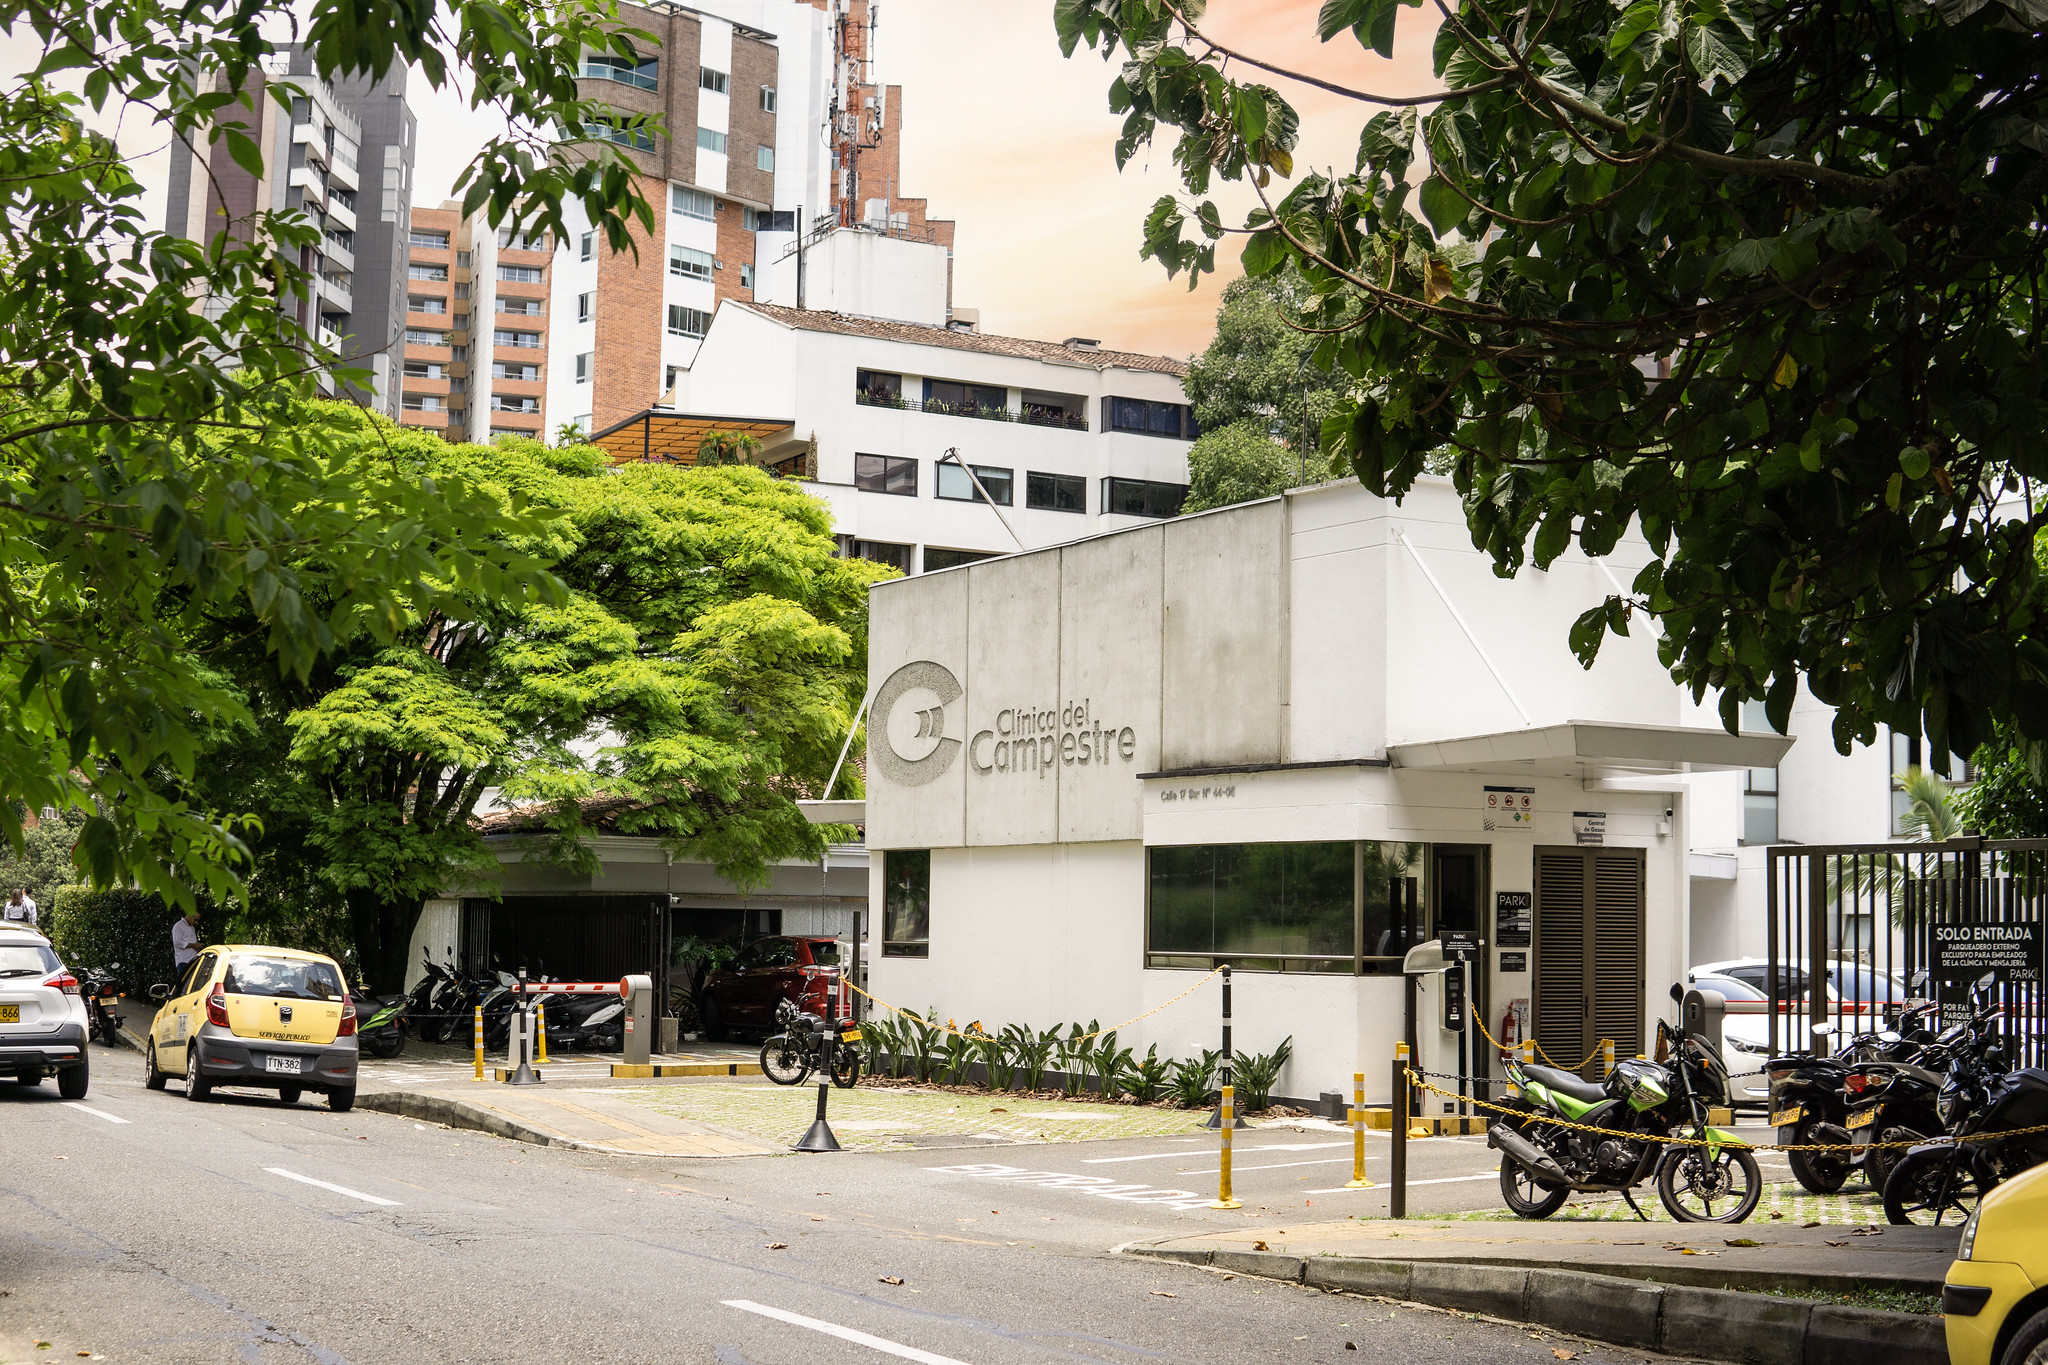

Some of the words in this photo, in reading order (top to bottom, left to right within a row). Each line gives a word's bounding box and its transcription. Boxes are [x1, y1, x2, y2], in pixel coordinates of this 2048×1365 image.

[996, 706, 1056, 737] Clínica
[1062, 698, 1090, 728] del
[969, 719, 1136, 780] Campestre
[1161, 790, 1177, 801] Calle
[1189, 788, 1200, 799] Sur
[1499, 895, 1526, 906] PARK
[1936, 927, 1971, 940] SOLO
[1973, 927, 2032, 940] ENTRADA
[1948, 943, 1992, 951] PARQUEADERO
[1993, 943, 2020, 951] EXTERNO
[1941, 951, 1974, 959] EXCLUSIVO
[1974, 951, 1991, 959] PARA
[1991, 951, 2028, 959] EMPLEADOS
[1942, 959, 1951, 967] DE
[1951, 959, 1959, 967] LA
[1960, 958, 1983, 967] CLÍNICA
[1984, 959, 1990, 967] Y
[1989, 958, 2027, 967] MENSAJERÍA
[2009, 968, 2035, 979] PARK
[258, 1031, 286, 1039] SERVICIO
[286, 1033, 311, 1041] PUBLICO
[267, 1056, 300, 1070] TTN-382
